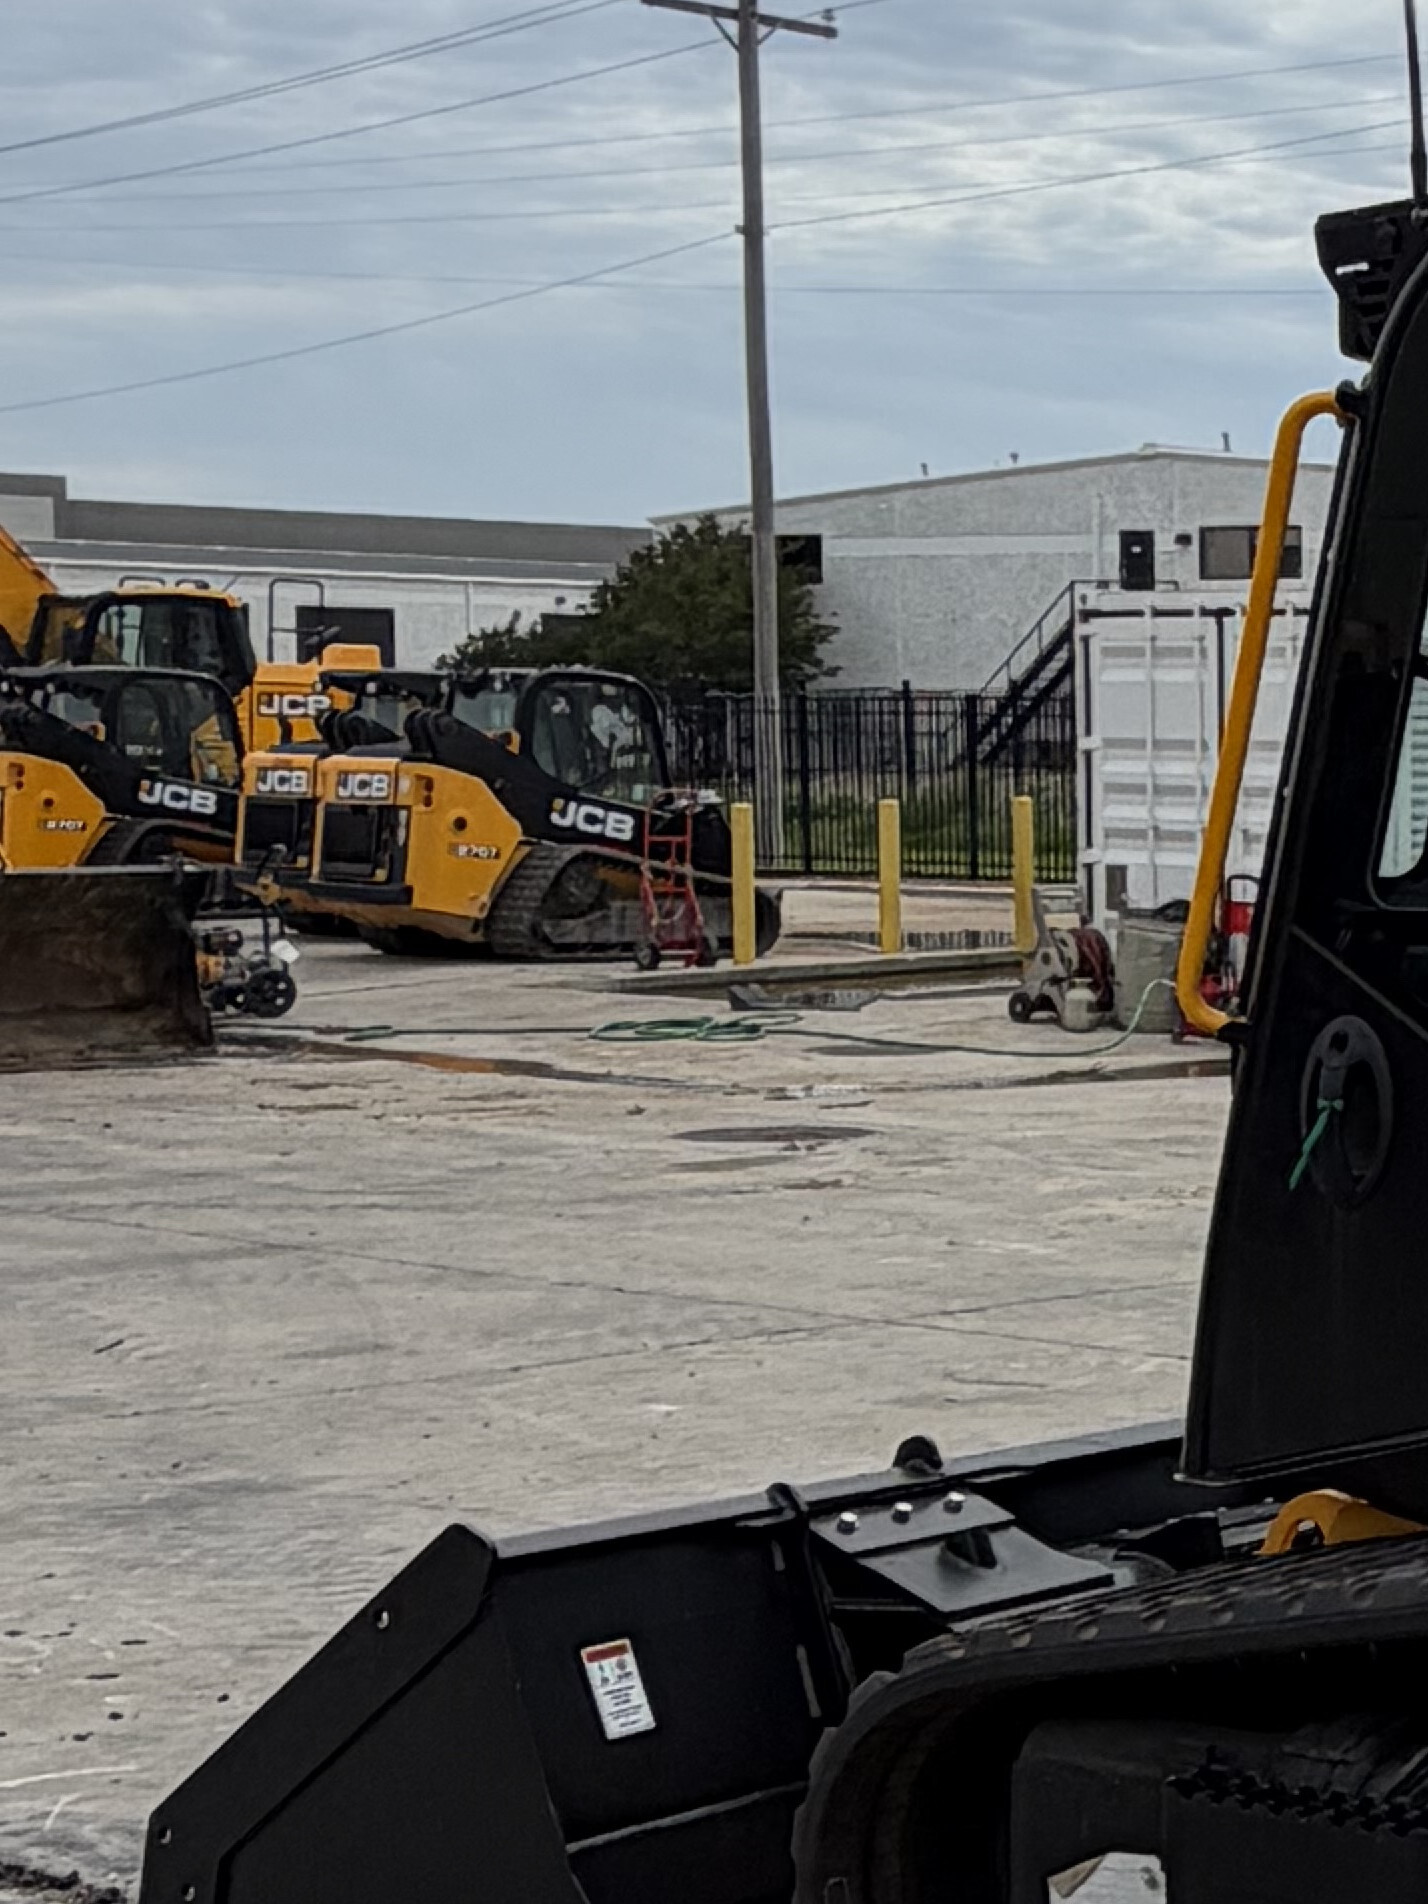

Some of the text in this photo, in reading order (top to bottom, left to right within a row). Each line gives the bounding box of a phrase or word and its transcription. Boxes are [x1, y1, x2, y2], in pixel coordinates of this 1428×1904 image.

[258, 771, 308, 792] JCB
[338, 774, 389, 798] JCB
[138, 781, 218, 814] JCB
[549, 800, 635, 841] JCB
